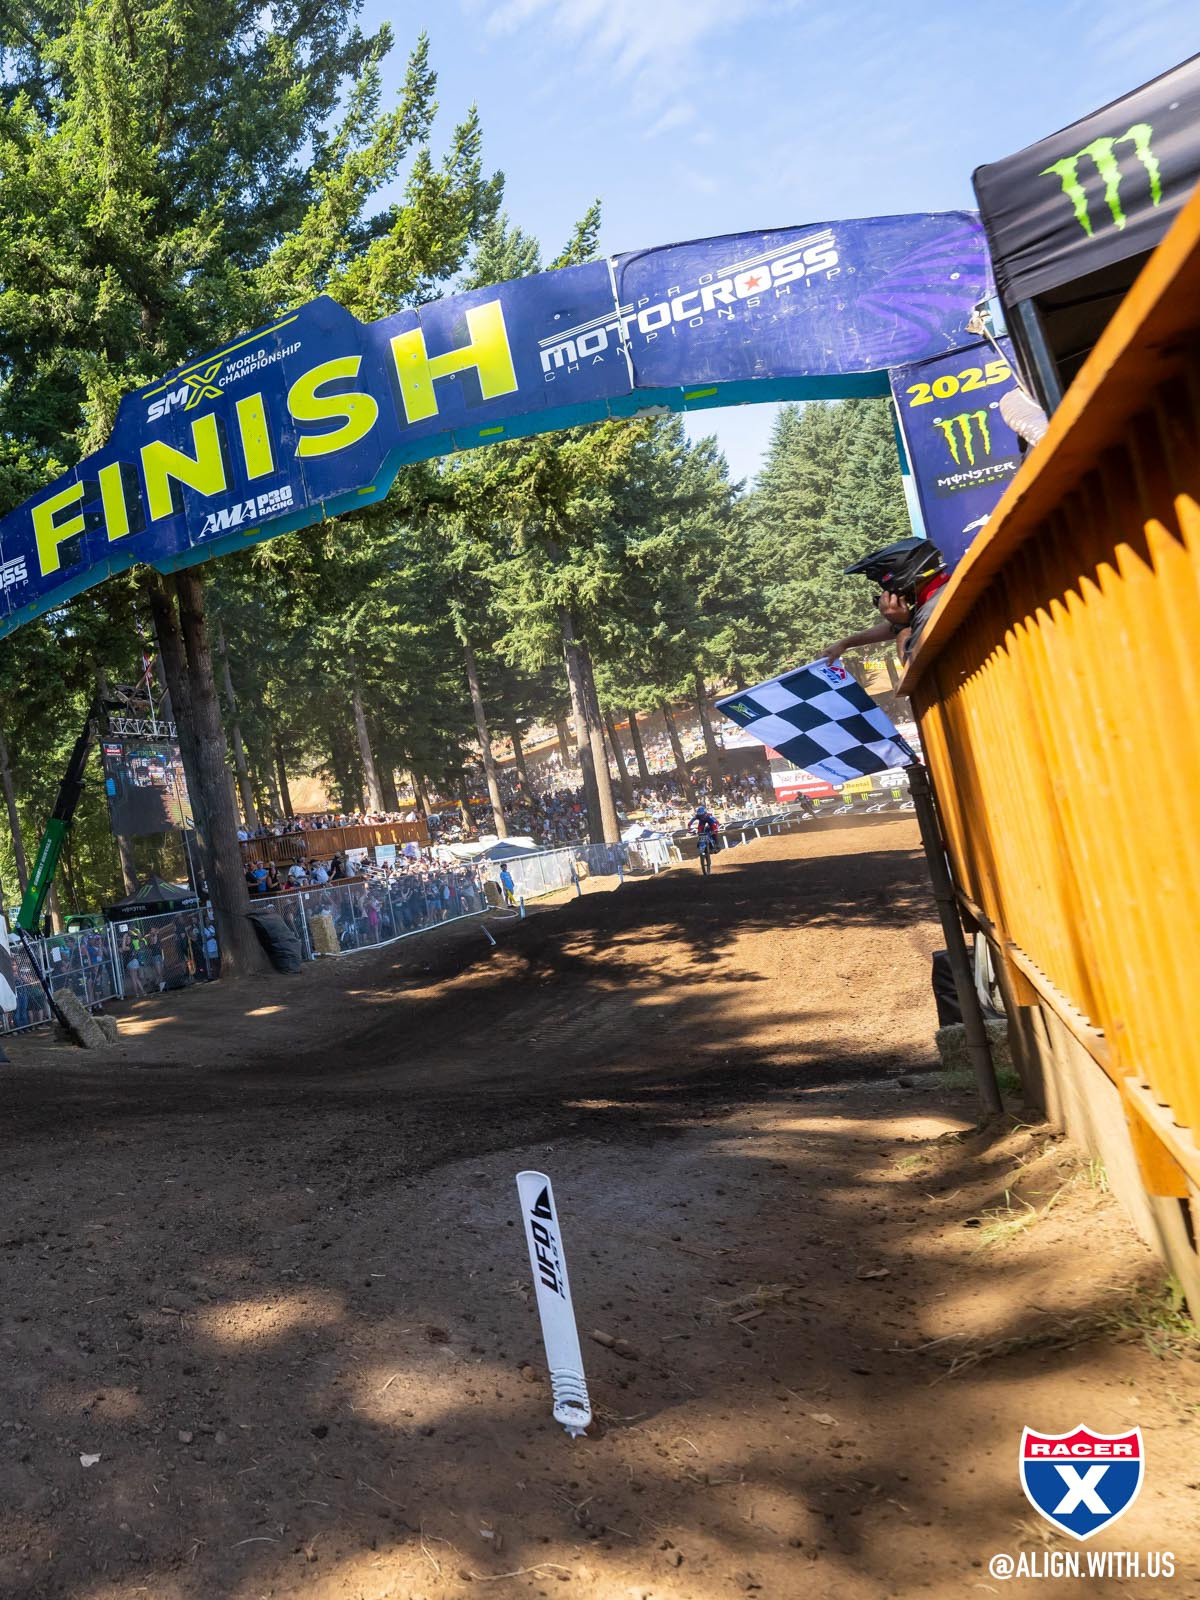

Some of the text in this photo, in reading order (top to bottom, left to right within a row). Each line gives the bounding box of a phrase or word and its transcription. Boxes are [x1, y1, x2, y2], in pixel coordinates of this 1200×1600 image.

[539, 240, 839, 373] MOTOCROSS
[637, 273, 714, 308] PRO
[544, 269, 841, 383] CHAMPIONSHIP
[218, 342, 302, 387] CHAMPIONSHIP
[226, 349, 266, 374] WORLD
[146, 360, 225, 423] SMX
[906, 359, 1012, 408] 2025
[30, 299, 519, 576] FINISH
[937, 461, 1017, 487] MONSTER
[950, 474, 1004, 490] ENERGY
[256, 485, 293, 509] PRO
[258, 498, 294, 516] RACING
[198, 499, 257, 538] AMA
[530, 1219, 560, 1294] UFO
